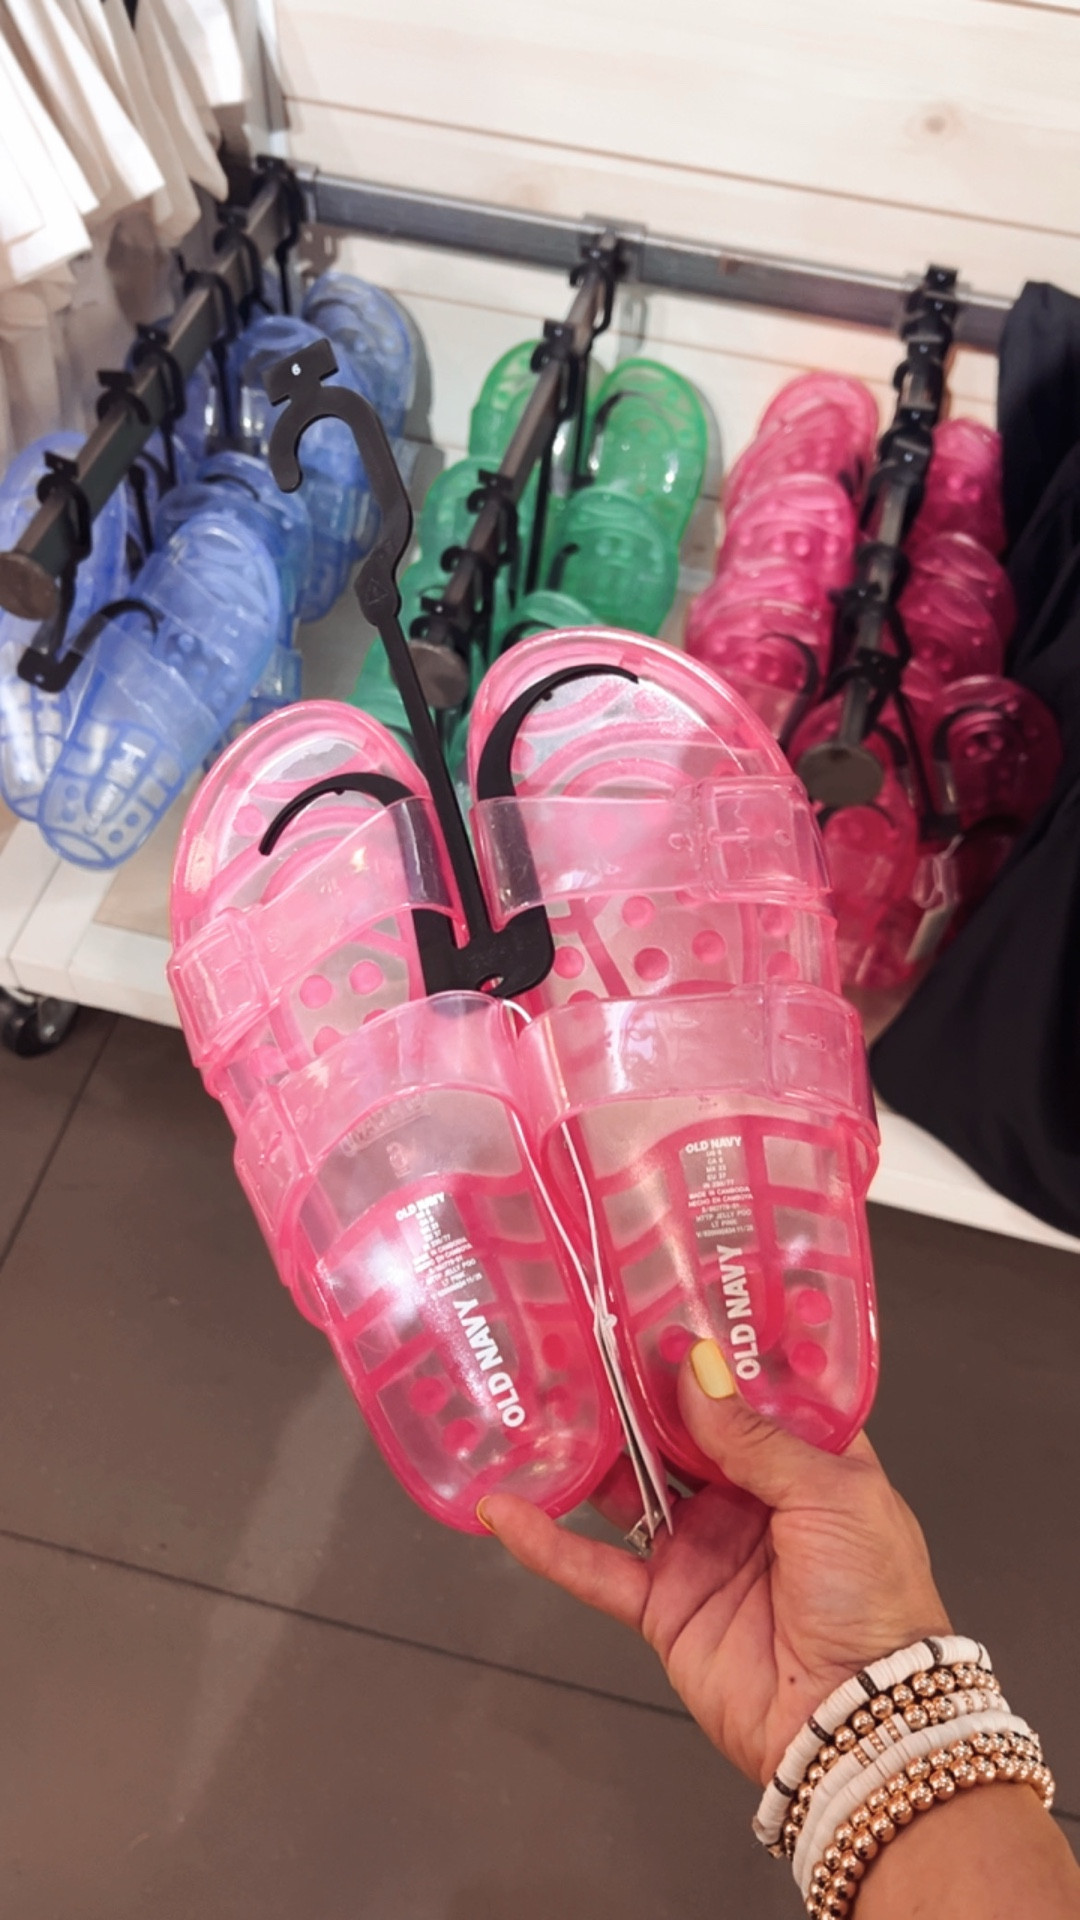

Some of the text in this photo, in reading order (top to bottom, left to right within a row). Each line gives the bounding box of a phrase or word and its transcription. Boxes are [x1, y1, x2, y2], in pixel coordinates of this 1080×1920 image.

[291, 363, 302, 376] 6
[685, 1136, 742, 1154] OLD NAVY
[717, 1186, 751, 1195] CAMBODIA
[395, 1203, 417, 1221] OLD
[717, 1245, 761, 1380] OLD NAVY
[453, 1298, 526, 1428] OLD NAVY
